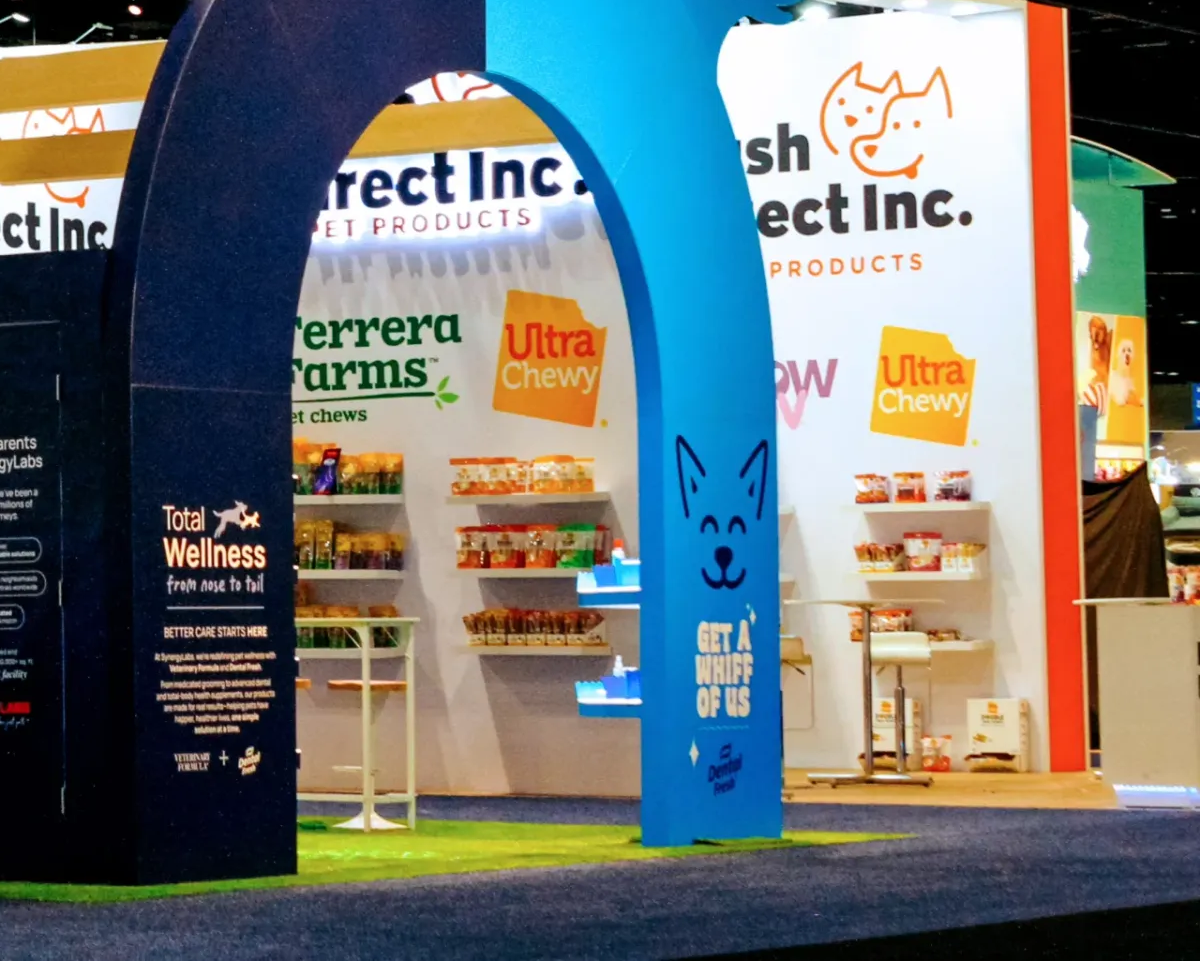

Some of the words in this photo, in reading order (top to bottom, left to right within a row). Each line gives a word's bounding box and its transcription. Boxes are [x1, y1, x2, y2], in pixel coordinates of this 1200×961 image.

[738, 123, 810, 175] sh
[322, 152, 455, 210] rect
[470, 151, 588, 202] Inc.
[314, 219, 355, 238] ET
[373, 208, 531, 235] PRODUCTS
[757, 183, 850, 238] ect
[863, 184, 973, 230] Inc.
[770, 253, 924, 279] PRODUCTS
[296, 314, 462, 351] errera
[506, 323, 595, 360] Ultra
[502, 361, 599, 393] Chewy
[880, 354, 966, 388] Ultra
[310, 408, 368, 424] chews
[877, 389, 969, 417] Chewy
[14, 489, 33, 497] been
[25, 499, 33, 508] of
[162, 505, 205, 532] Total
[163, 537, 266, 568] Wellness
[166, 574, 197, 595] from
[200, 578, 225, 593] nose
[229, 575, 241, 591] to
[245, 573, 264, 593] tail
[164, 627, 194, 638] BETTER
[195, 626, 216, 638] CARE
[217, 626, 246, 638] STARTS
[247, 626, 268, 637] HERE
[697, 621, 733, 653] GET
[737, 619, 752, 652] A
[695, 652, 754, 685] WHIFF
[696, 685, 721, 718] OF
[724, 686, 751, 718] US
[708, 754, 743, 782] Dental
